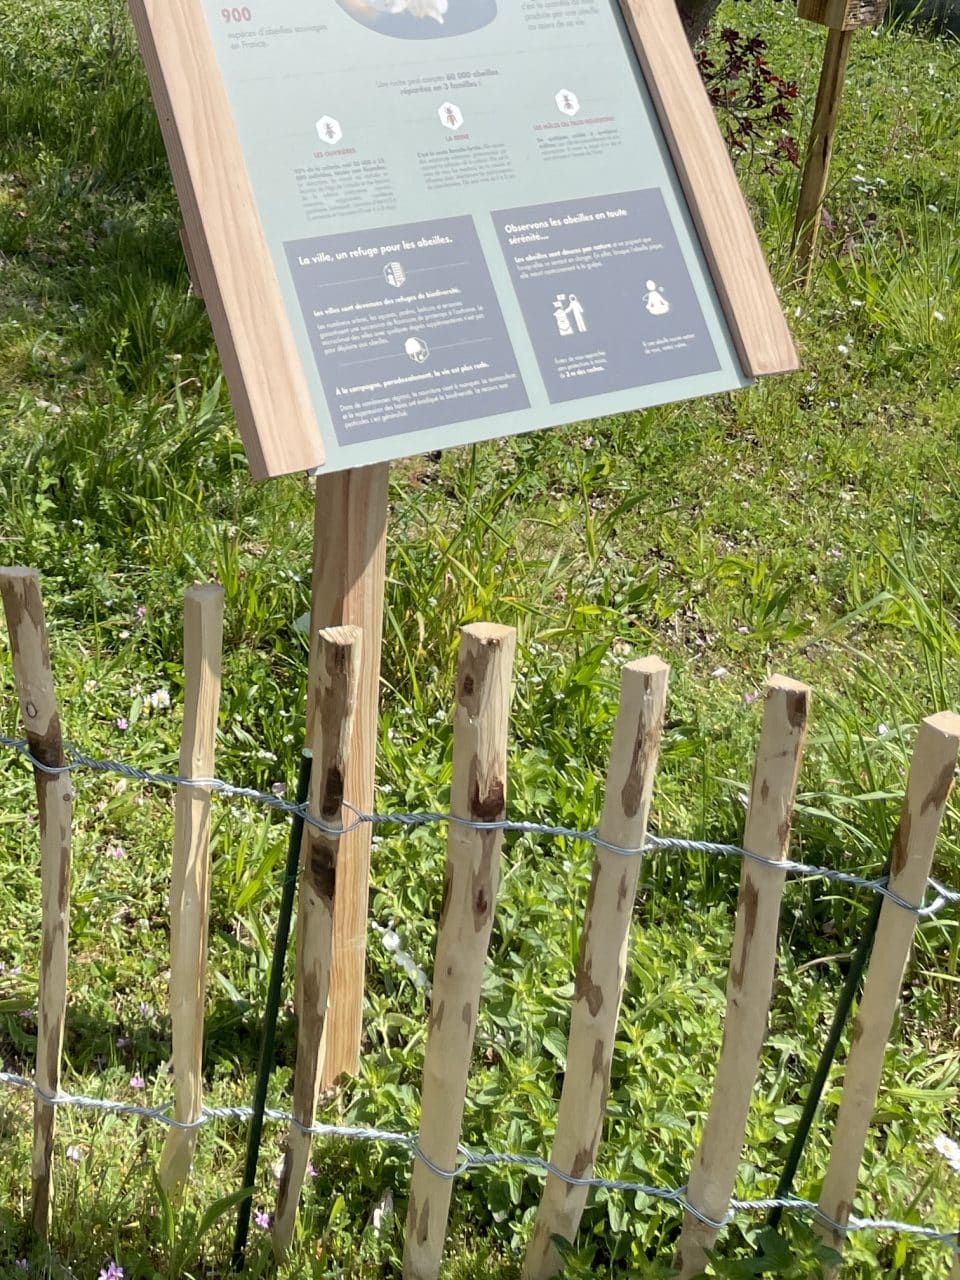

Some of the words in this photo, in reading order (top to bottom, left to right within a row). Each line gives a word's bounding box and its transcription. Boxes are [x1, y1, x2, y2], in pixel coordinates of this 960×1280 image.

[221, 6, 252, 23] 900
[504, 221, 549, 235] Observons
[549, 216, 562, 228] les
[562, 213, 594, 225] abeilles
[594, 211, 606, 221] en
[606, 207, 628, 220] toute
[297, 256, 311, 267] La
[311, 252, 335, 264] ville,
[335, 251, 349, 261] un
[349, 246, 380, 259] refuge
[380, 244, 402, 256] pour
[402, 239, 417, 251] les
[416, 234, 454, 249] abeilles.
